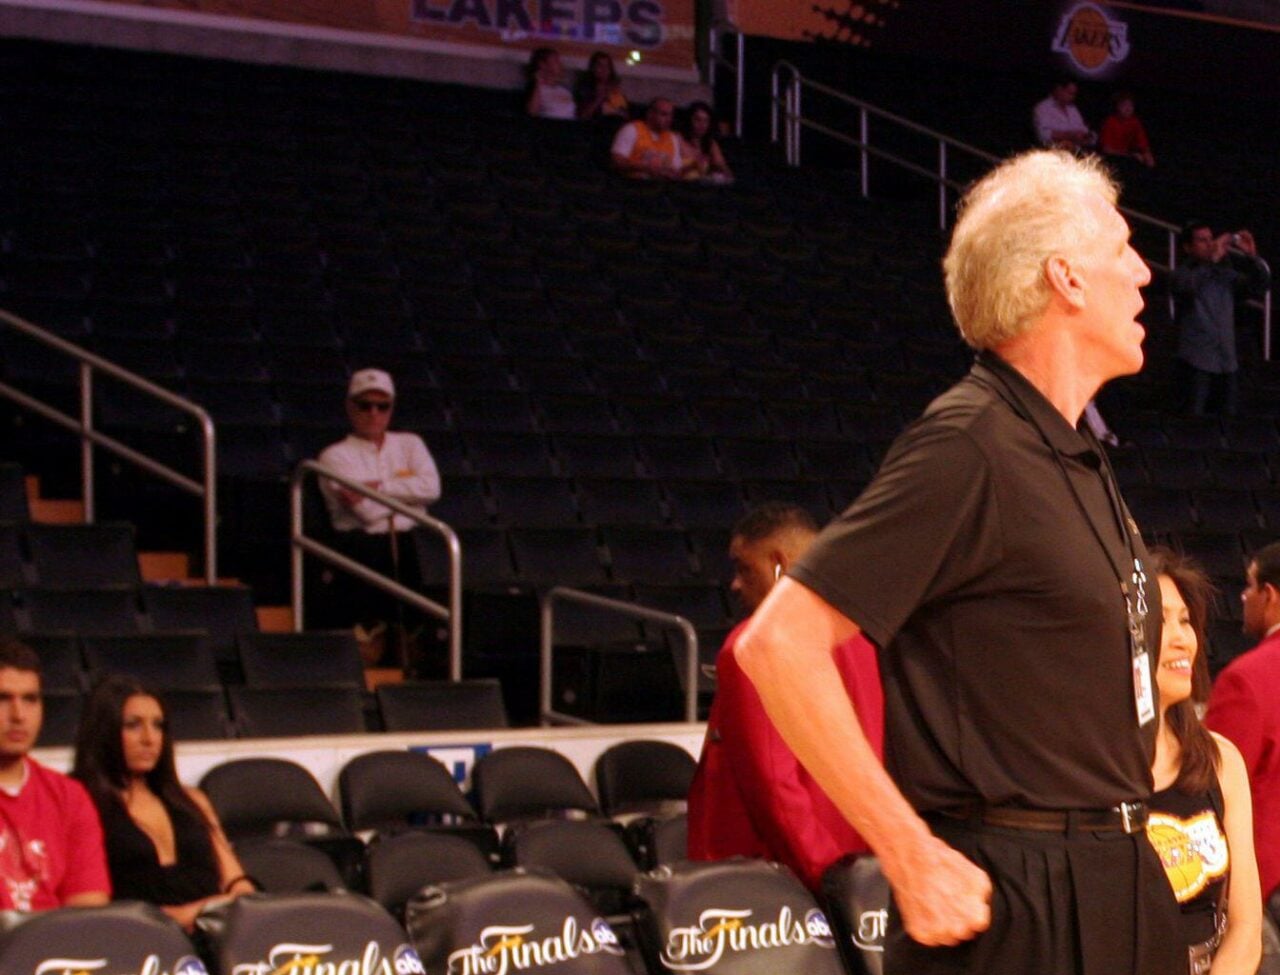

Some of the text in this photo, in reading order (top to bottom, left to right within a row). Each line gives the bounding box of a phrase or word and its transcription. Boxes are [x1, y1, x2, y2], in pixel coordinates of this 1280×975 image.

[593, 924, 618, 945] ab
[666, 926, 712, 961] The
[680, 905, 805, 971] Finals
